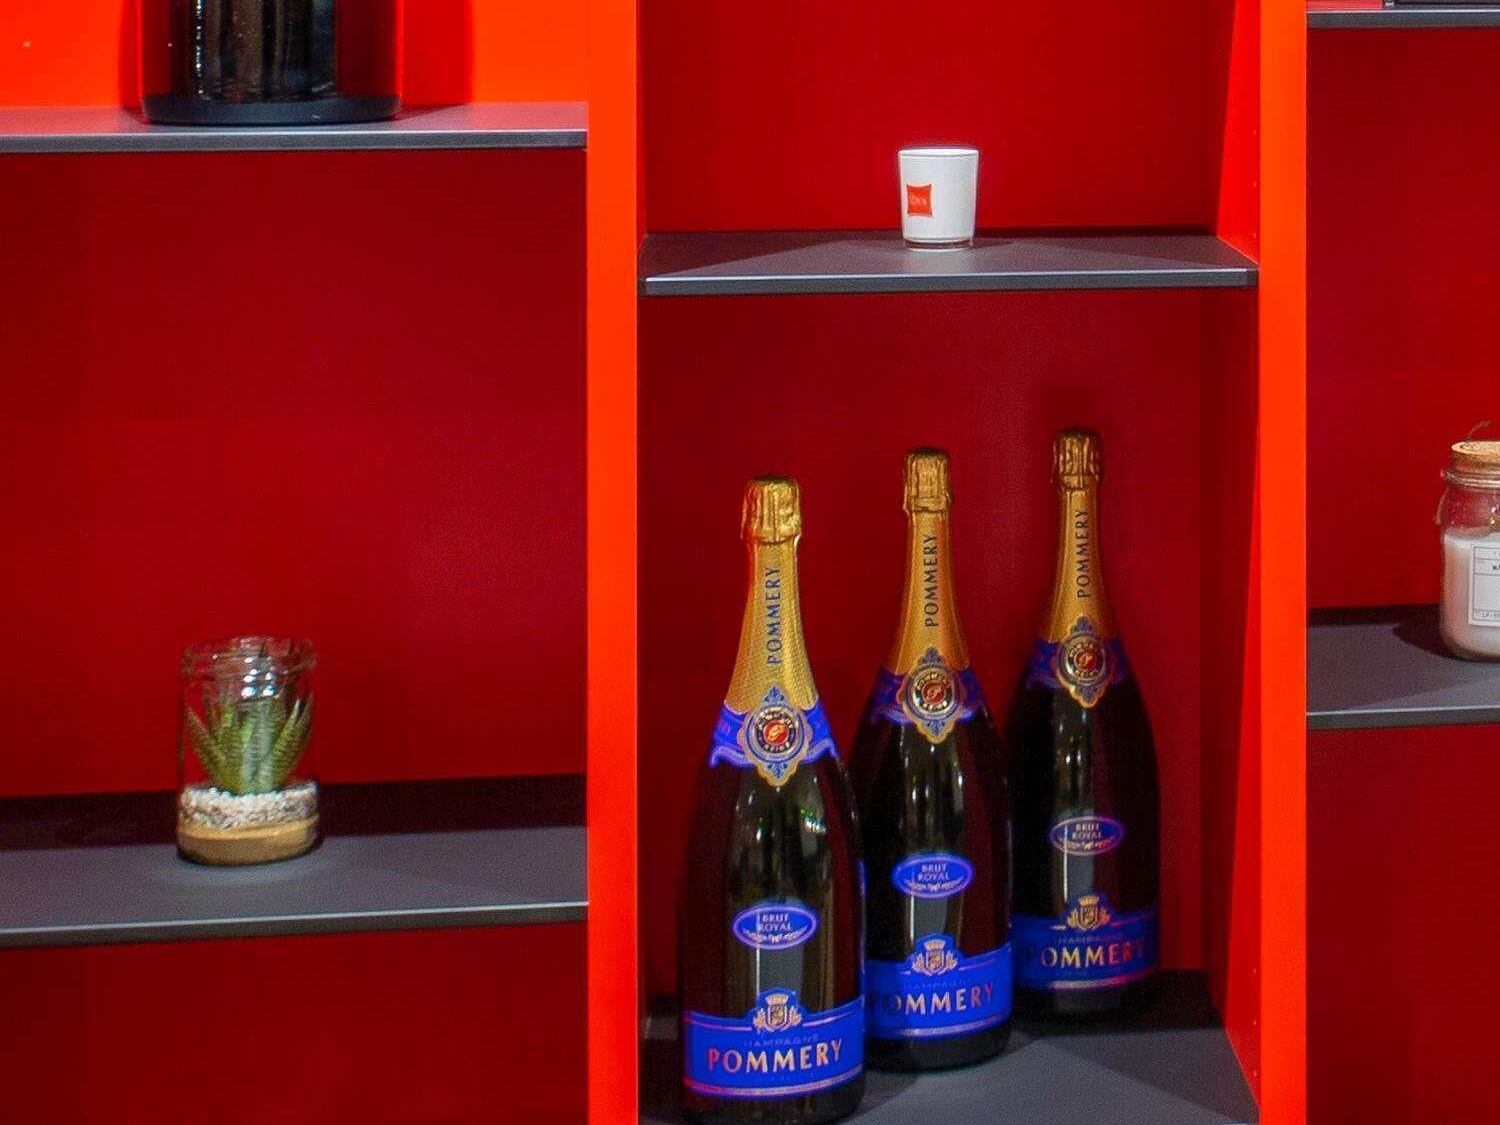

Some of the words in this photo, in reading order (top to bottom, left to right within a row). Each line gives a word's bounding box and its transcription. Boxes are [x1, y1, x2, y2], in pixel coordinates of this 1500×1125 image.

[1075, 508, 1092, 600] POMMERY
[924, 532, 939, 628] POMMERY
[765, 565, 782, 667] POMMERY
[1076, 824, 1100, 832] BRUT
[1072, 832, 1104, 840] ROYAL
[921, 863, 947, 872] BRUT
[917, 872, 951, 881] ROYAL
[763, 913, 790, 923] BRUT
[758, 922, 792, 932] ROYAL
[707, 1038, 843, 1073] POMMERY
